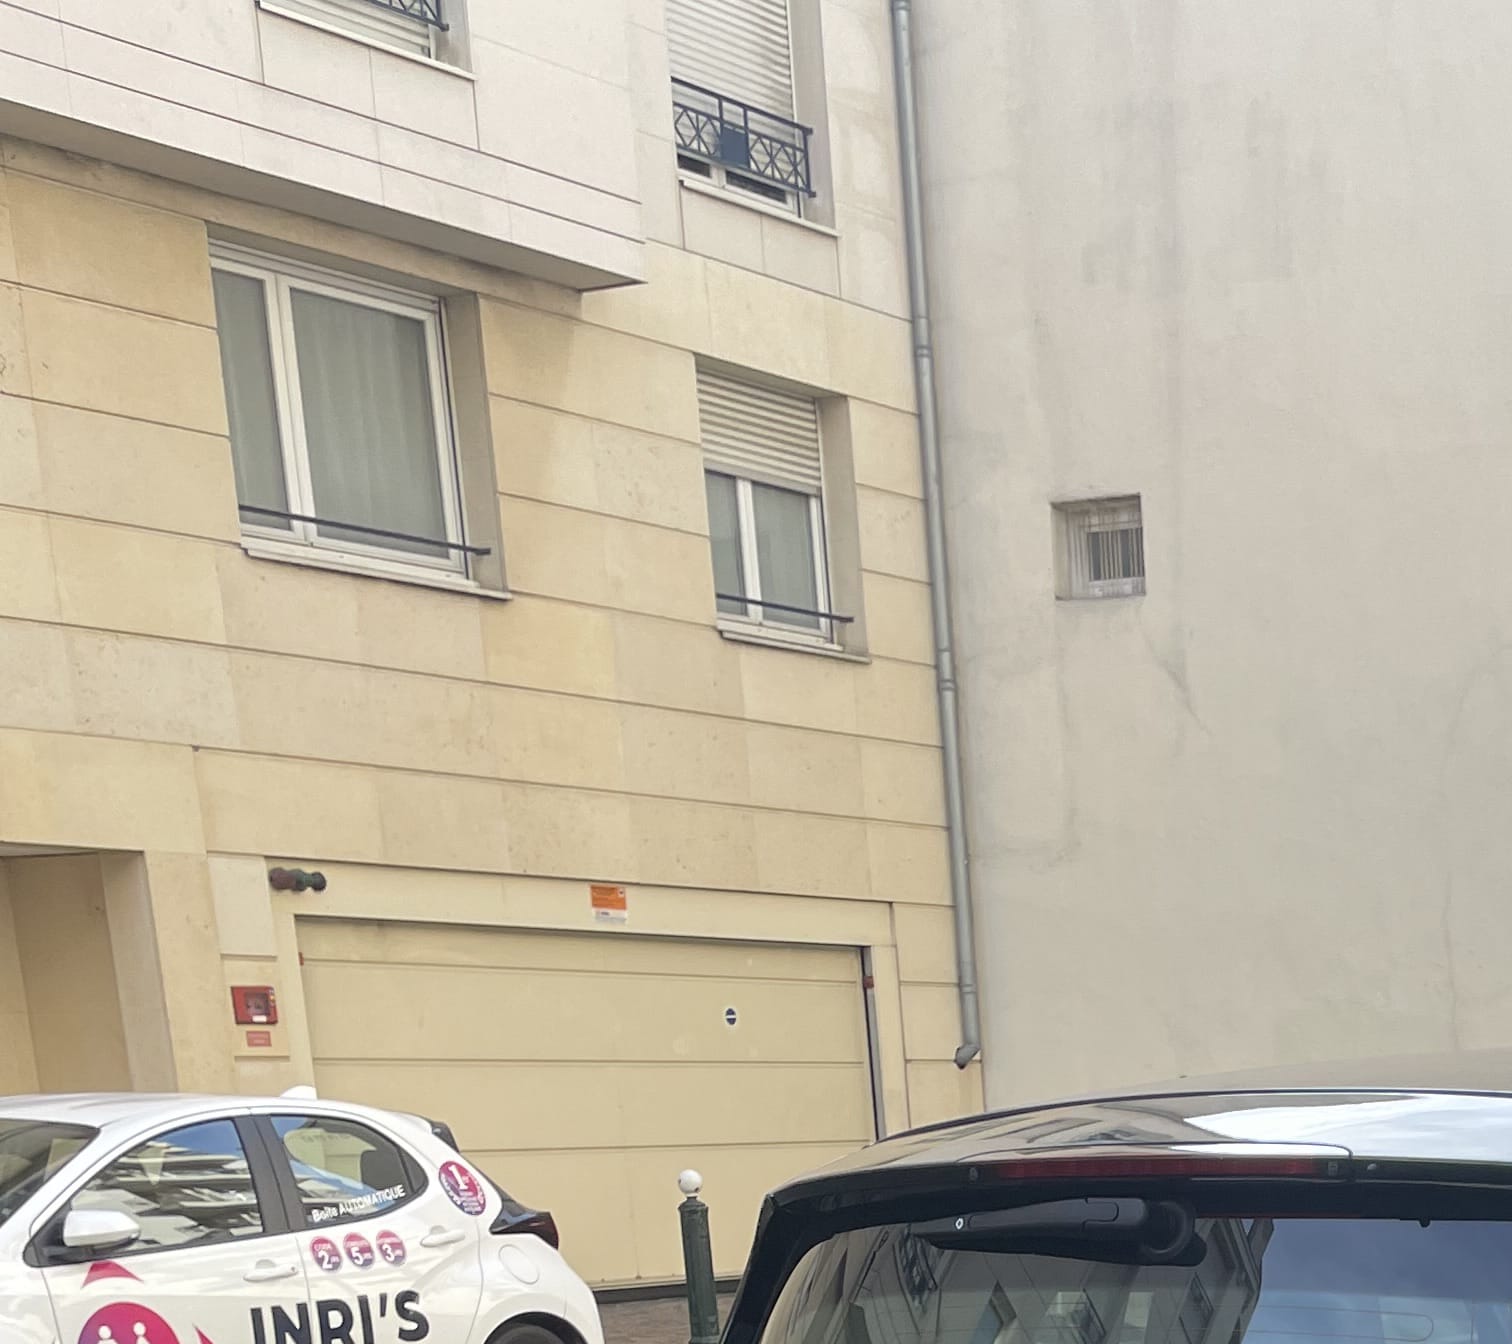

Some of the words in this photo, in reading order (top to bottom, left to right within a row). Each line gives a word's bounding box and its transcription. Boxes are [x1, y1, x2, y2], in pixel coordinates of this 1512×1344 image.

[338, 1185, 406, 1216] AUTOMATIQUE
[318, 1250, 333, 1269] 2
[350, 1246, 363, 1265] 5
[382, 1243, 395, 1262] 3
